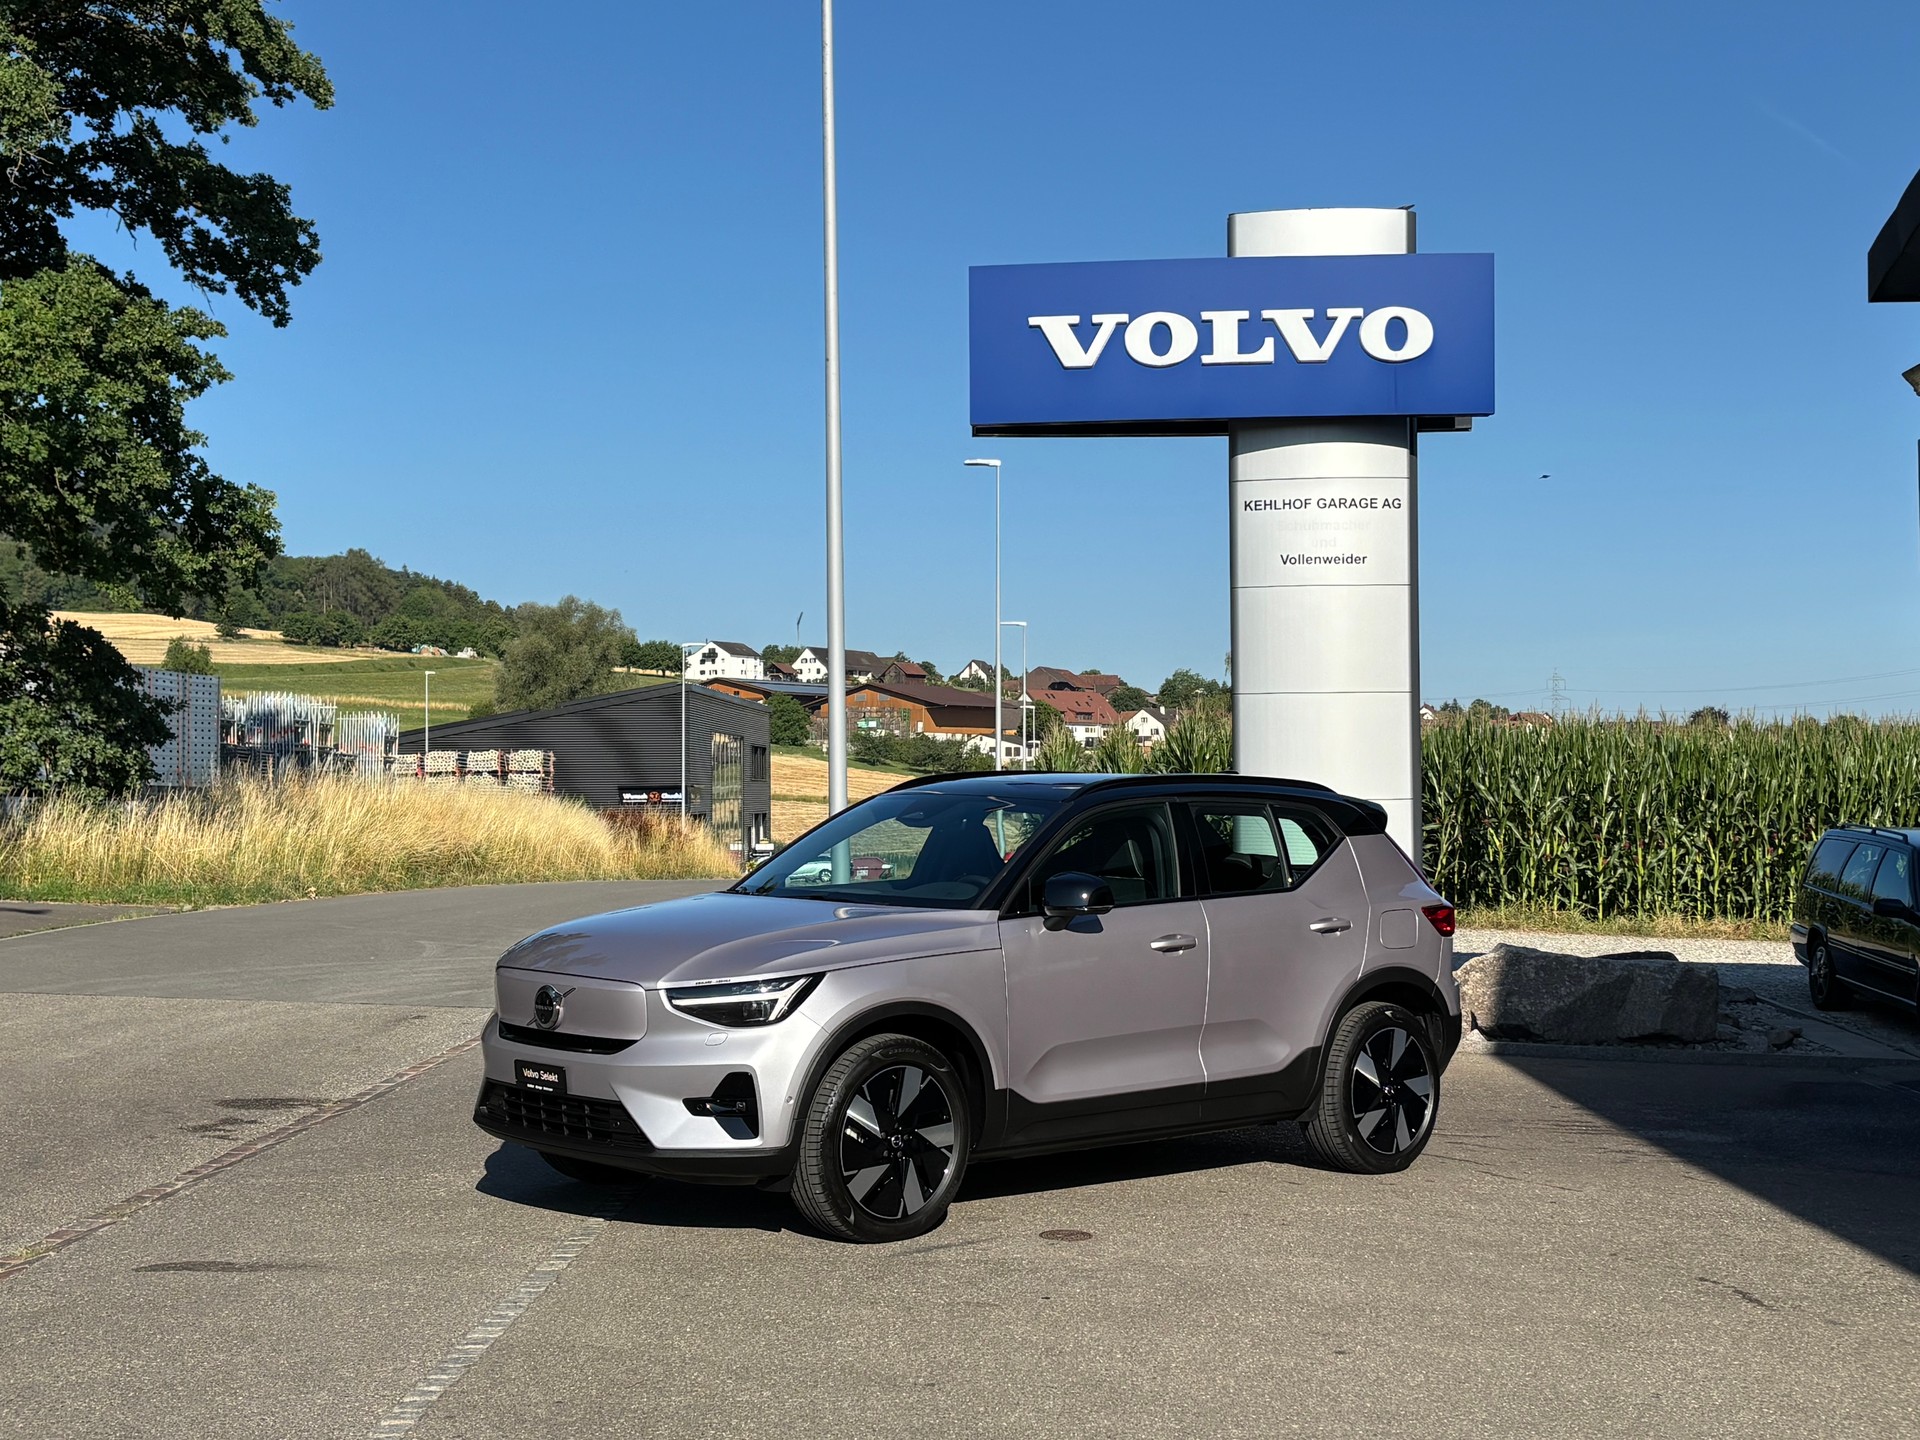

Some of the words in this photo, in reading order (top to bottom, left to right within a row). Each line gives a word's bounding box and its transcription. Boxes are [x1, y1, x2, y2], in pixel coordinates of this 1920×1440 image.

[1028, 305, 1434, 369] VOLVO
[1244, 498, 1312, 512] KEHLHOF
[1316, 497, 1378, 510] GARAGE
[1381, 497, 1402, 510] AG
[1280, 553, 1368, 566] Vollenweider
[522, 1067, 539, 1079] Volvo
